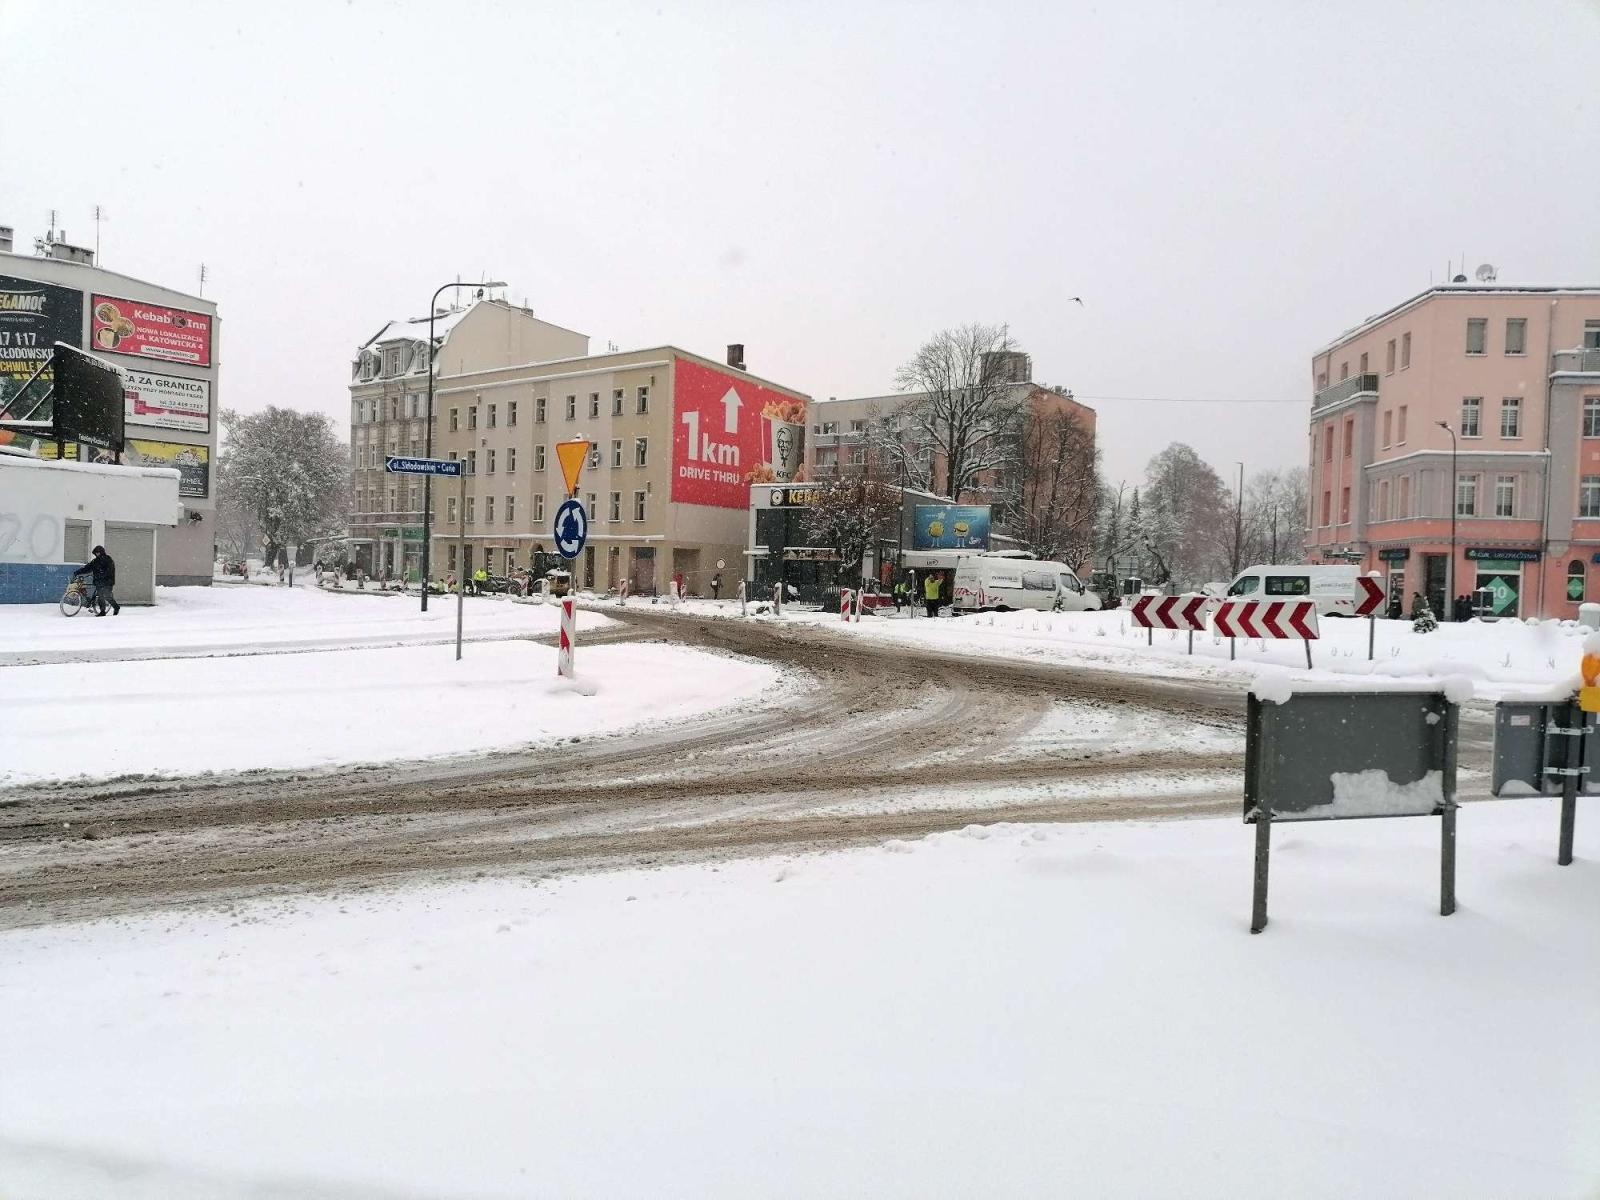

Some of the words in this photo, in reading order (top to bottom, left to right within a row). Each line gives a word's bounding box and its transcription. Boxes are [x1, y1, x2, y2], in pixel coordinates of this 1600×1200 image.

[133, 309, 171, 324] Kebab
[187, 318, 207, 330] Inn
[136, 326, 159, 336] NOWA
[159, 330, 203, 343] LOKALIZACJA
[148, 335, 197, 349] KATOWICKA
[198, 343, 204, 351] 4
[138, 376, 153, 386] ZA
[155, 379, 204, 394] GRANICĄ
[679, 466, 711, 481] DRIVE
[713, 471, 741, 485] THRU
[776, 471, 792, 479] KFC
